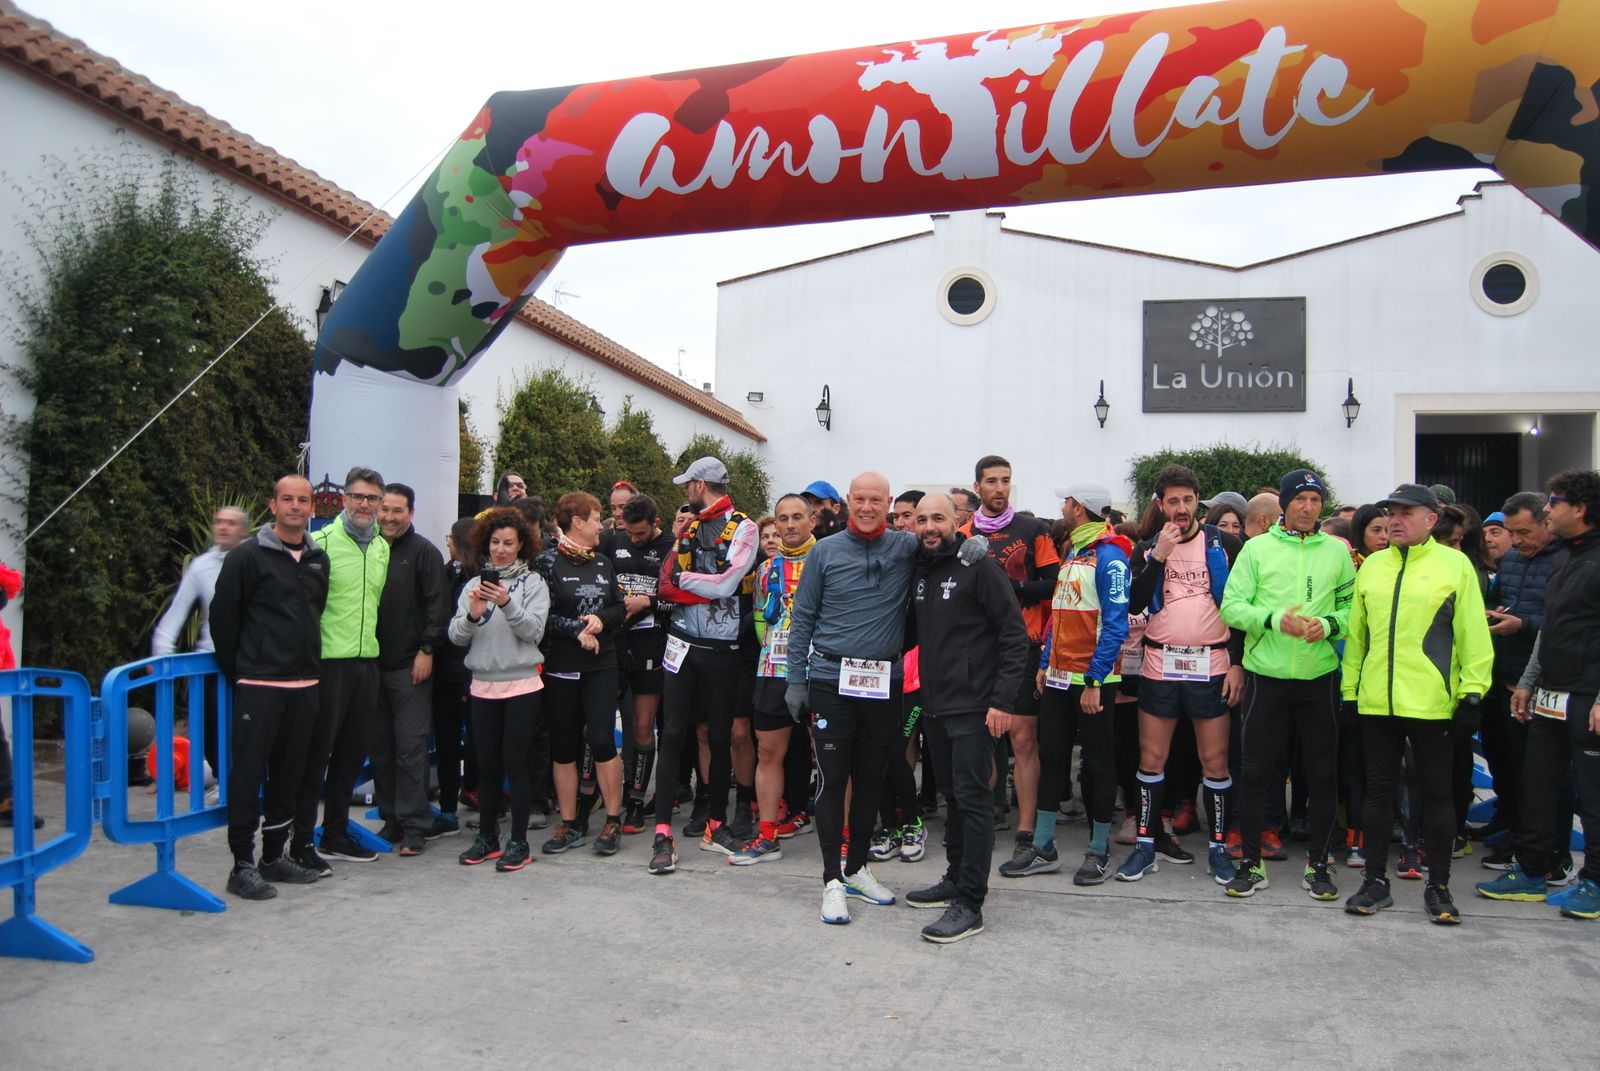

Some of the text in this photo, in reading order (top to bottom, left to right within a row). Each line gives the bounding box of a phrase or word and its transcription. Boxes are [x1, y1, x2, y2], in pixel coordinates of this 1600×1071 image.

[1153, 363, 1294, 389] La Unión
[1002, 539, 1026, 556] TRAIL
